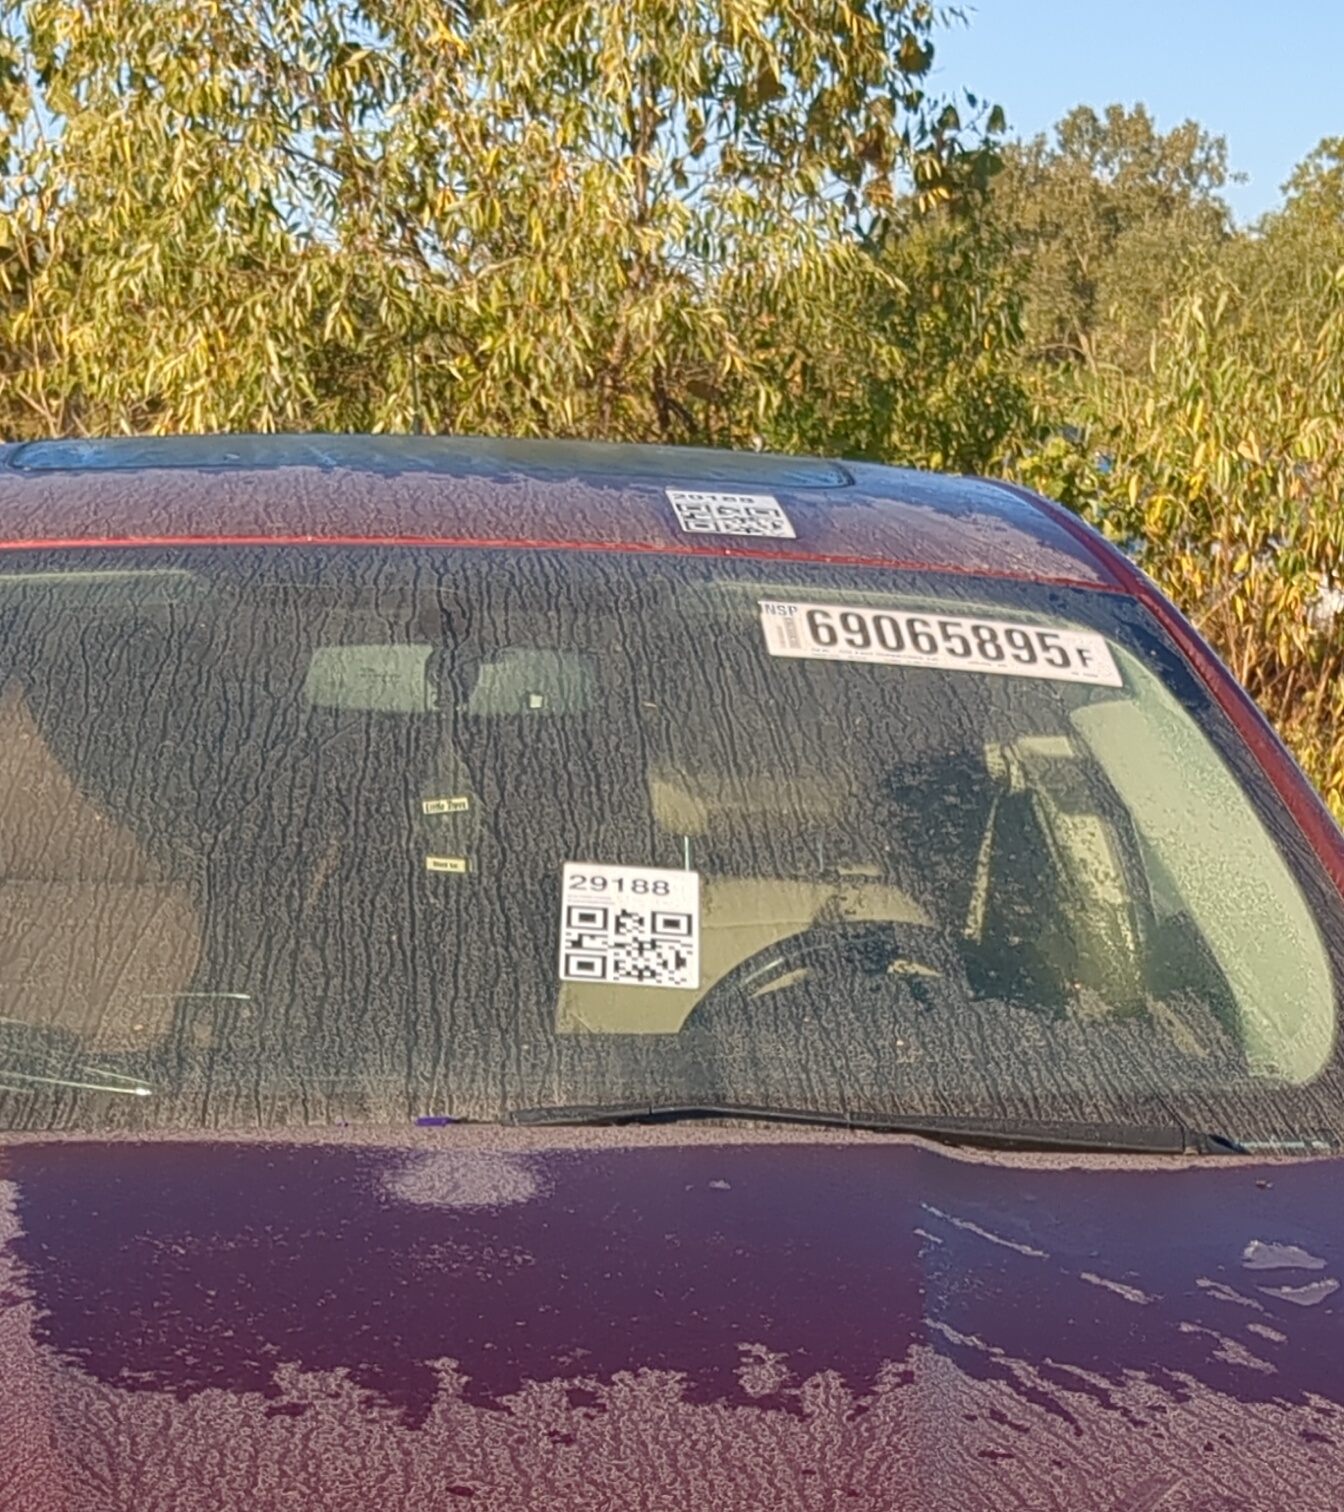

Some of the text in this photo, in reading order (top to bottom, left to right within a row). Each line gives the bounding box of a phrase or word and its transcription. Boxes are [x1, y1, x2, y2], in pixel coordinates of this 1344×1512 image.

[805, 609, 1071, 669] 69065895
[1076, 648, 1094, 668] F
[568, 874, 671, 896] 29188
